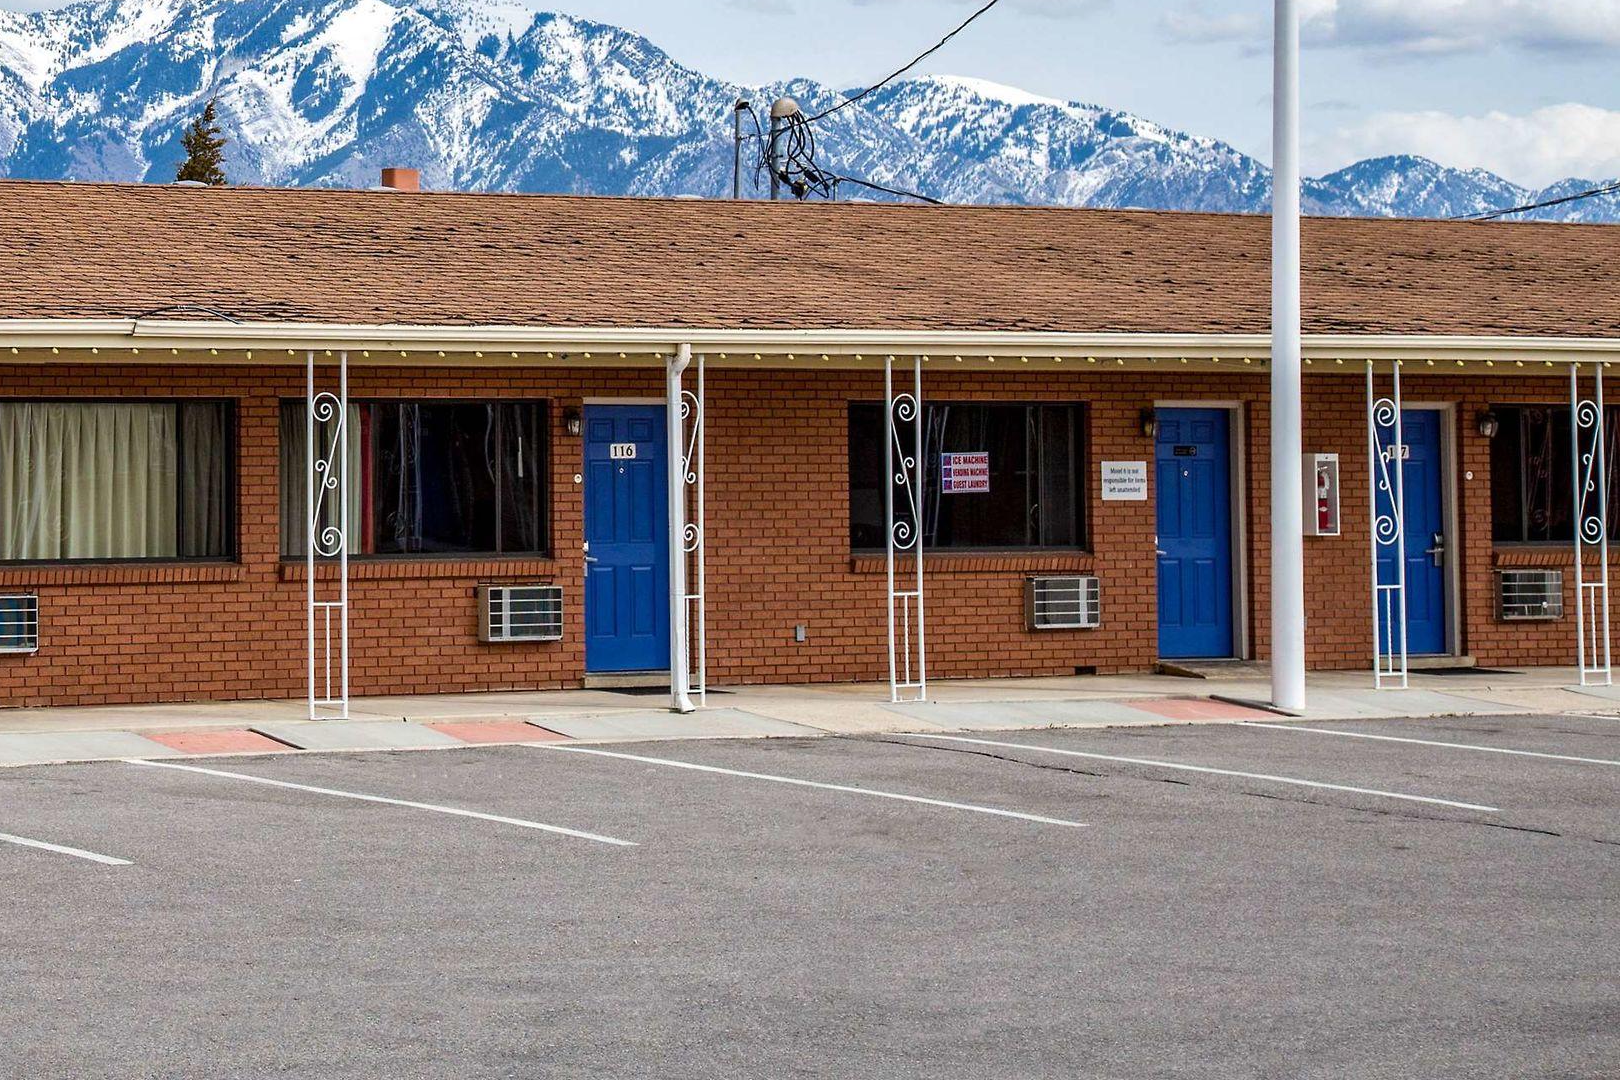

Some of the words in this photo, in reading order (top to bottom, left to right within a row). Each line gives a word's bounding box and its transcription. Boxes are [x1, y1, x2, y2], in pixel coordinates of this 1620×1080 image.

[613, 445, 633, 457] 116
[1390, 447, 1406, 457] 17
[953, 456, 962, 465] ICE
[963, 456, 988, 464] MACHINE
